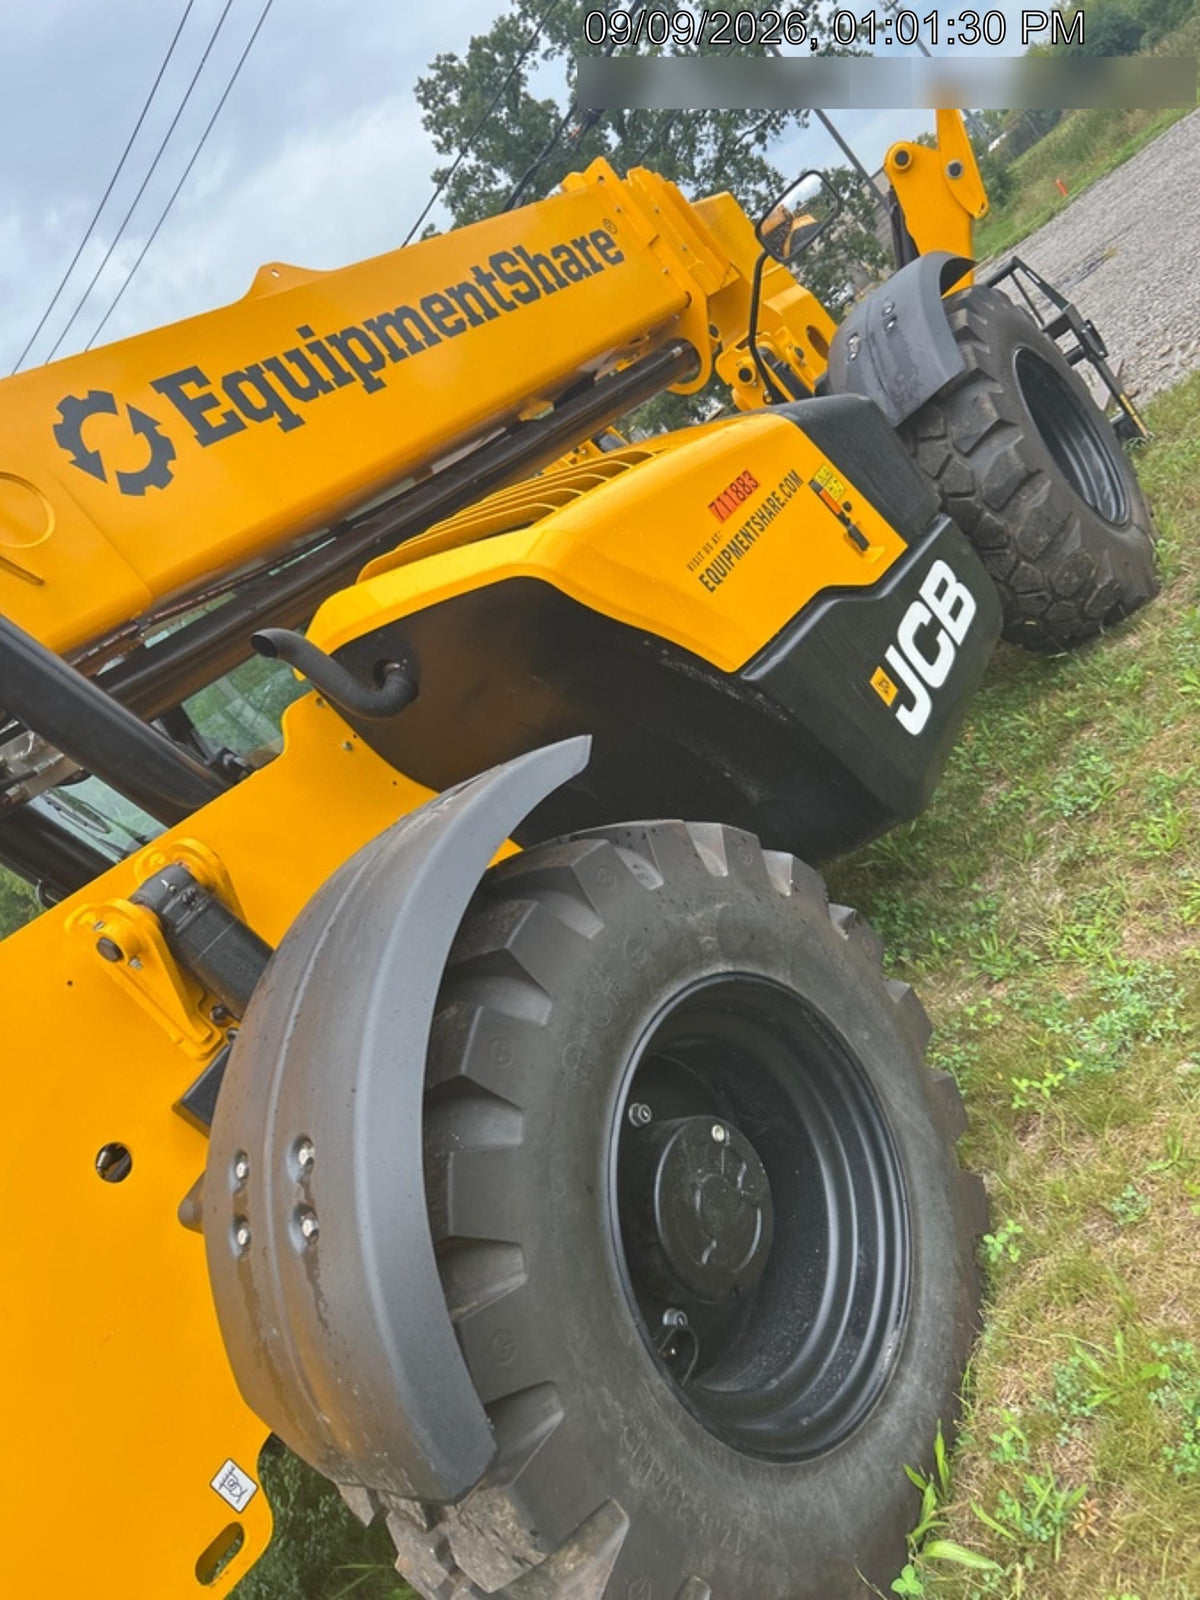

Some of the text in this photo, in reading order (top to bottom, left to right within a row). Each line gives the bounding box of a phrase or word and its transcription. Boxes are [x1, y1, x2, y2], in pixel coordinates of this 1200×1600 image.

[698, 469, 804, 593] EQUIPMENTSHARE.COM
[708, 470, 758, 521] 711883
[884, 559, 977, 736] JCB
